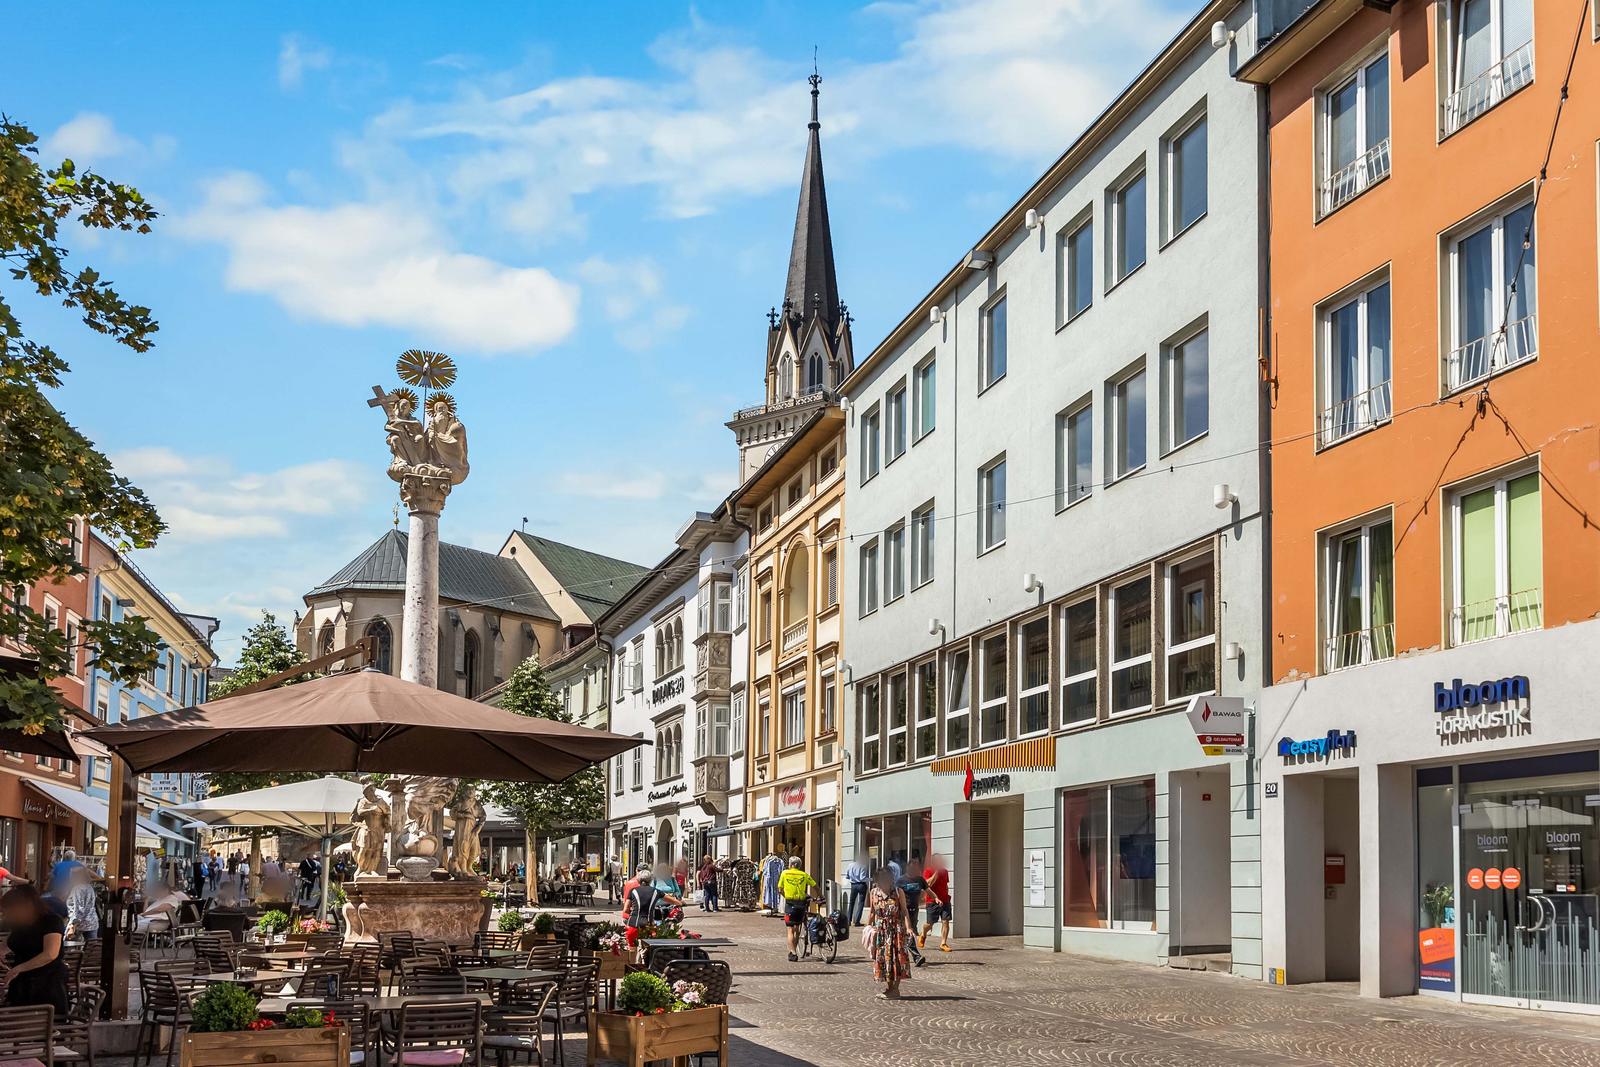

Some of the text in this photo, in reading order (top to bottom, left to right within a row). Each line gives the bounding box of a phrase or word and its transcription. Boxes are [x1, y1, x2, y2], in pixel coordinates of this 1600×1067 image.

[1434, 675, 1530, 712] bloom
[1266, 783, 1277, 793] 20
[1476, 834, 1509, 846] bloom
[1545, 831, 1582, 843] bloom
